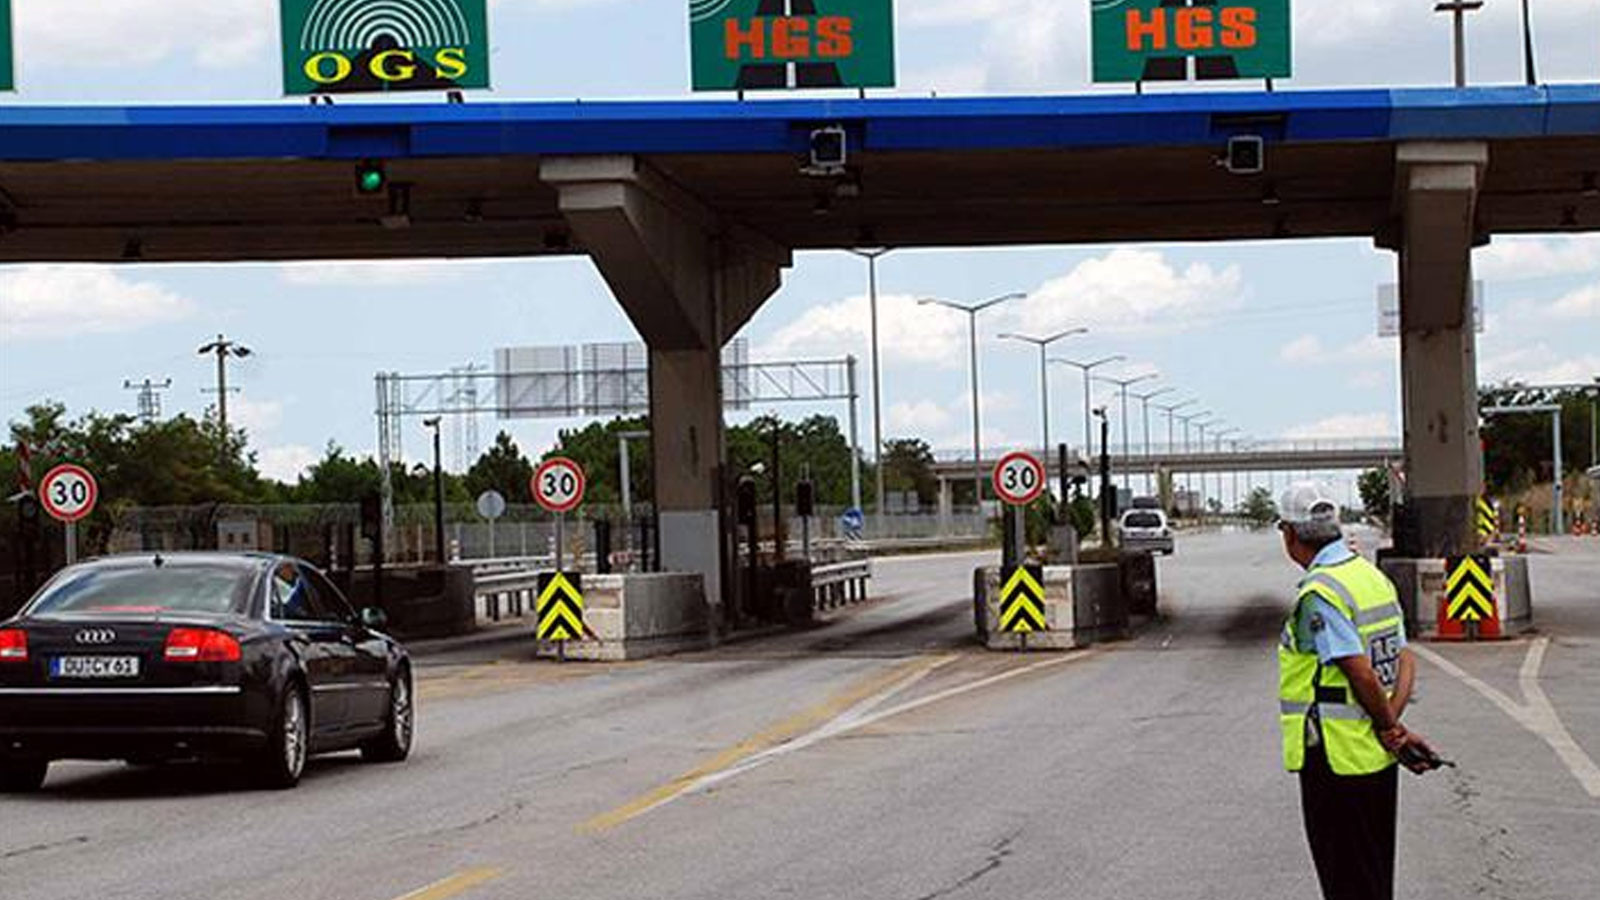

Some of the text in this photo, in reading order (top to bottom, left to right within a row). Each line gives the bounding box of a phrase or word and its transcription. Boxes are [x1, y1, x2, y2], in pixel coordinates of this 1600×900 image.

[725, 15, 853, 60] HGS
[1126, 6, 1257, 51] HGS
[303, 48, 467, 84] OGS
[53, 480, 87, 506] 30
[543, 472, 575, 497] 30
[1004, 465, 1035, 490] 30
